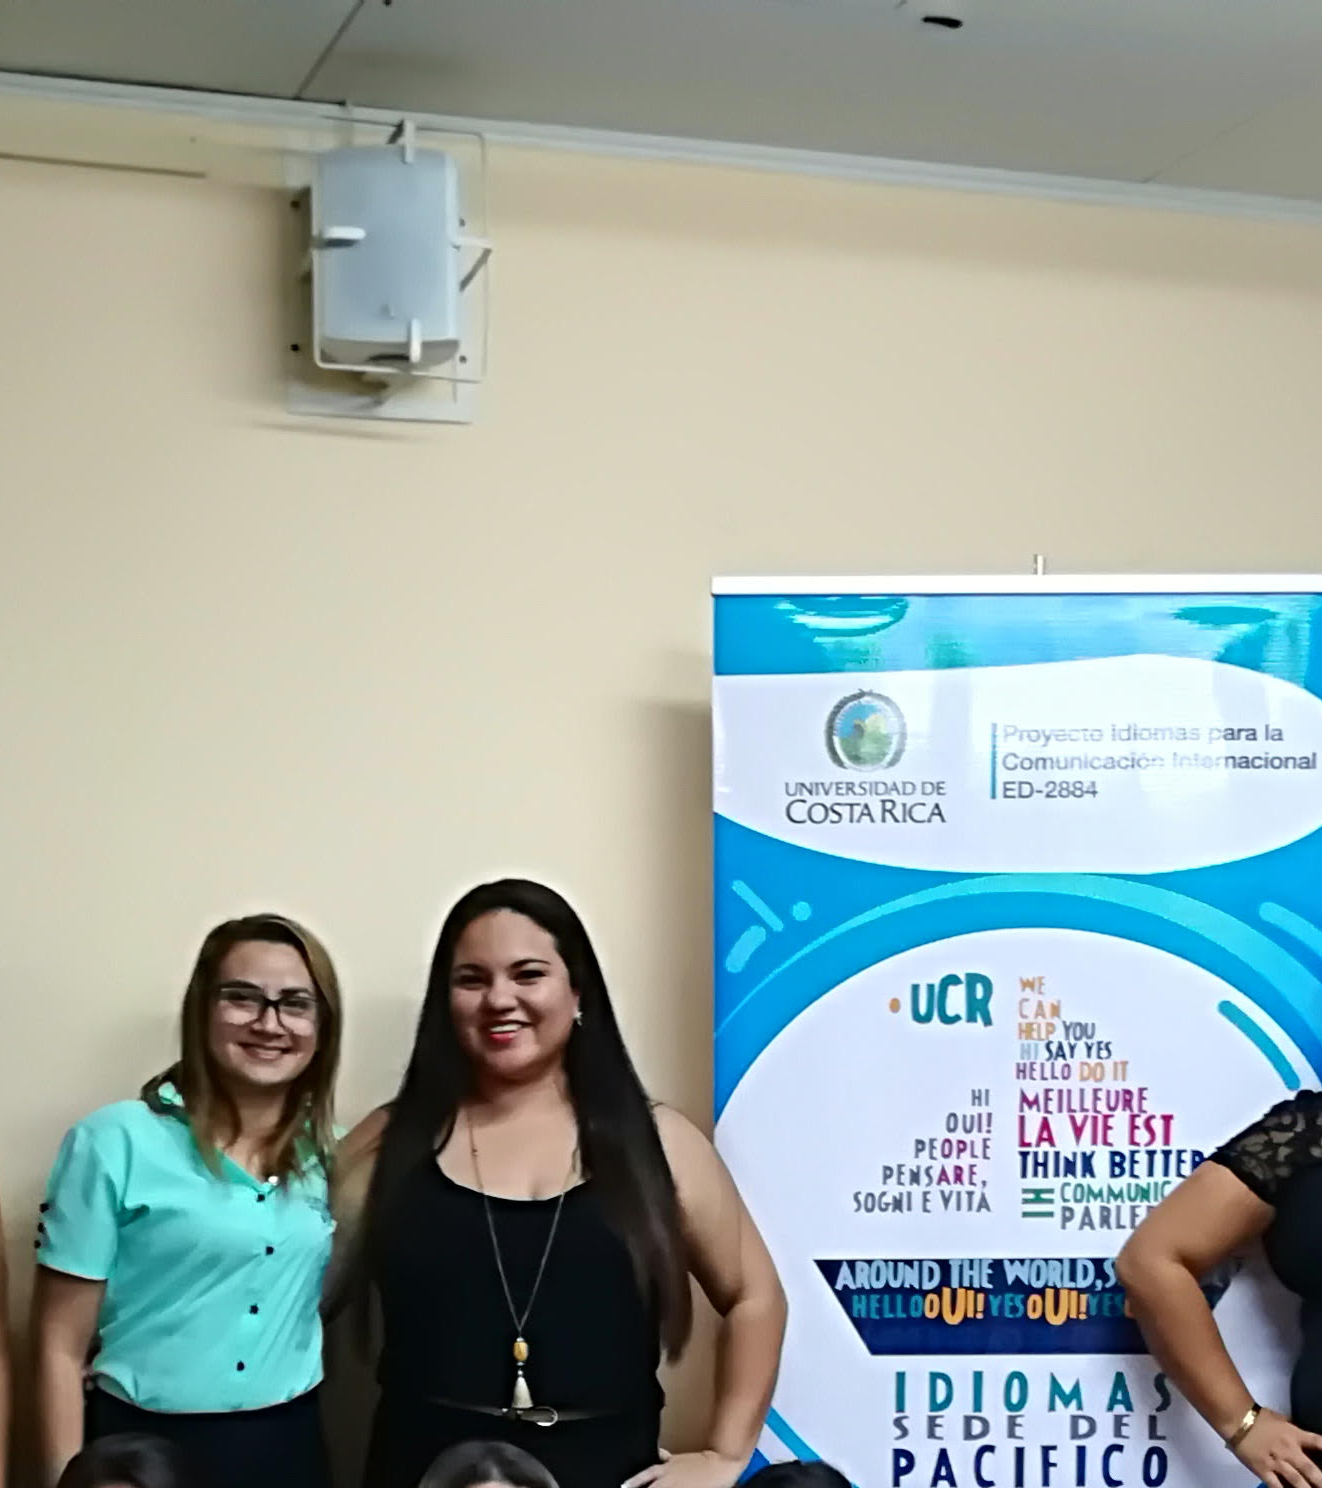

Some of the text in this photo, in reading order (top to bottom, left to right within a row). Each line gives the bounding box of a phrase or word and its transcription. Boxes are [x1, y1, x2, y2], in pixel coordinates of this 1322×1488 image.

[1003, 725, 1103, 747] Proyecto
[1208, 727, 1258, 745] para
[1265, 723, 1284, 742] la
[1002, 751, 1317, 771] Comunicación Internacional
[784, 781, 947, 797] UNIVERSIDAD DE
[1002, 780, 1098, 799] ED-2884
[784, 799, 947, 824] COSTA RICA
[1019, 976, 1046, 995] WE
[910, 972, 994, 1027] UCR
[1018, 998, 1062, 1019] CAN
[1018, 1020, 1097, 1041] HELP YOU
[1020, 1040, 1112, 1061] HI SAY YES
[1015, 1060, 1129, 1082] HELLO DO IT
[971, 1089, 990, 1107] HI
[1018, 1087, 1149, 1114] MEILLEURE
[945, 1112, 993, 1134] OUI!
[1018, 1114, 1175, 1148] LA VIE EST
[914, 1137, 992, 1160] PEOPLE
[1018, 1149, 1205, 1179] THINK BETTER
[881, 1164, 988, 1189] PENSARE,
[852, 1190, 913, 1214] SOGNI
[921, 1190, 932, 1213] E
[1060, 1204, 1156, 1231] PARLE
[834, 1259, 942, 1291] AROUND
[948, 1258, 994, 1289] THE
[894, 1370, 1171, 1413] IDIOMAS
[892, 1414, 1167, 1441] SEDE DEL
[891, 1443, 1169, 1488] PACIFICO
